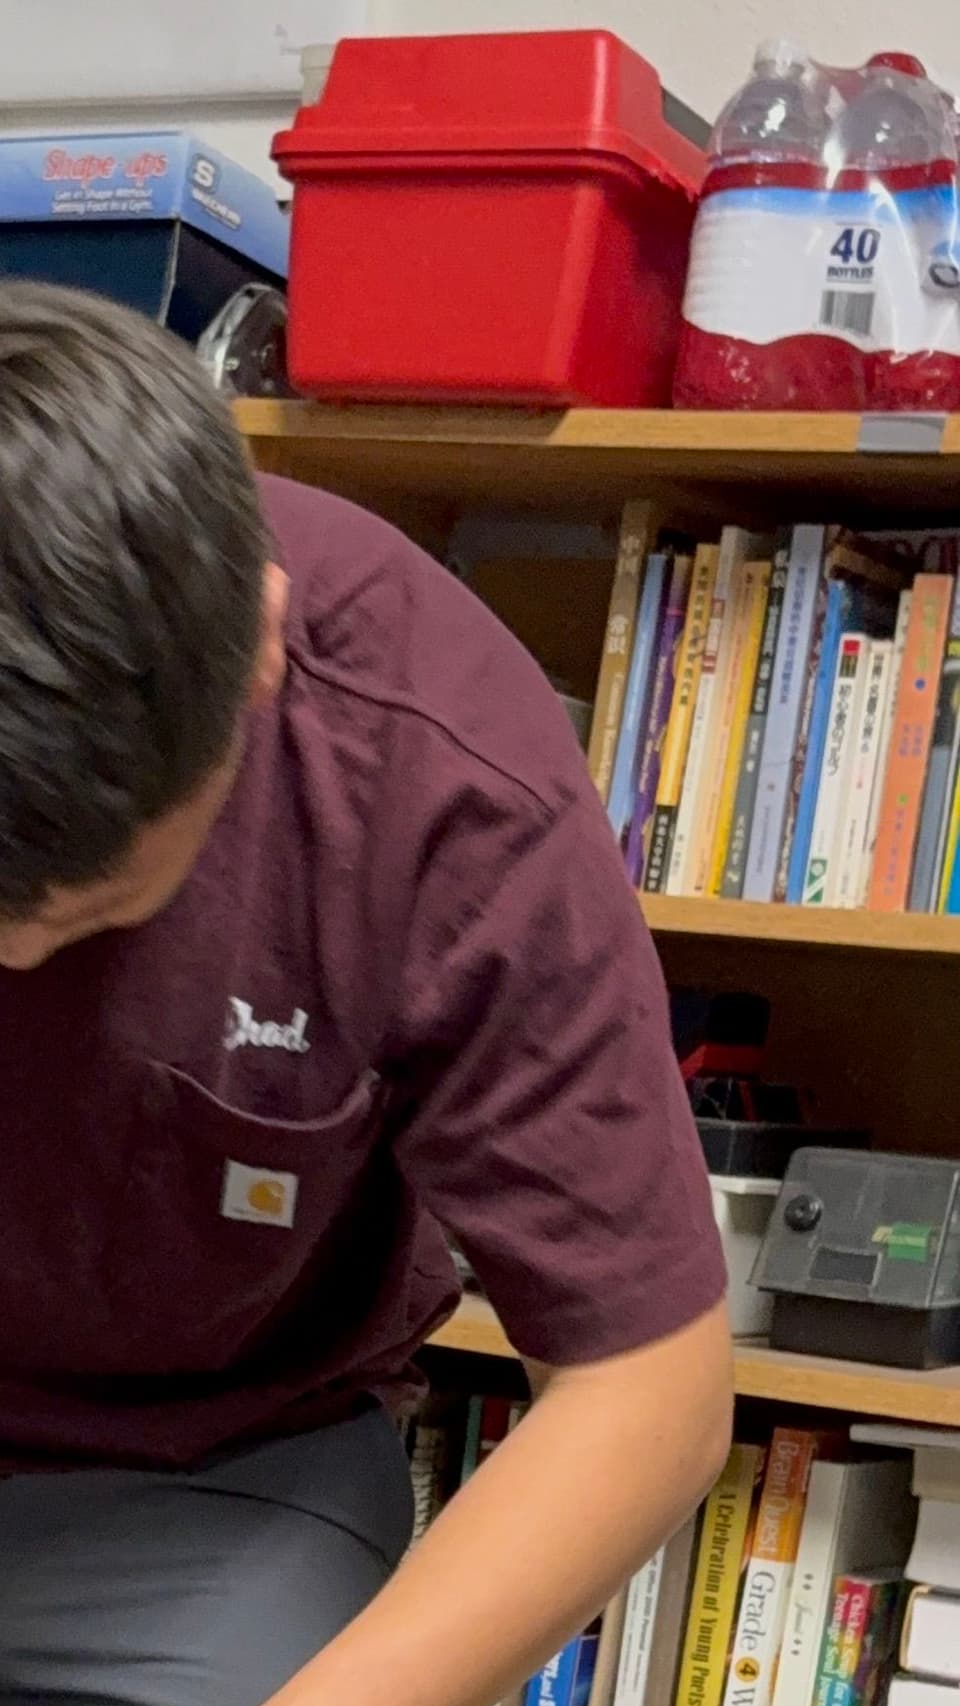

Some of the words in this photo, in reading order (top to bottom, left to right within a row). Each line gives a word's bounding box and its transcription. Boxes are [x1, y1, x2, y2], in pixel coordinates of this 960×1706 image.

[830, 228, 881, 264] 40
[828, 266, 874, 279] BOTTLES
[772, 1441, 800, 1490] Brain
[705, 1503, 736, 1594] Celebration
[758, 1497, 791, 1553] Quest
[701, 1596, 721, 1612] of
[740, 1570, 777, 1651] Grade
[844, 1592, 863, 1644] Chicken
[691, 1616, 718, 1664] Young
[822, 1644, 839, 1675] Soul
[833, 1680, 850, 1699] for
